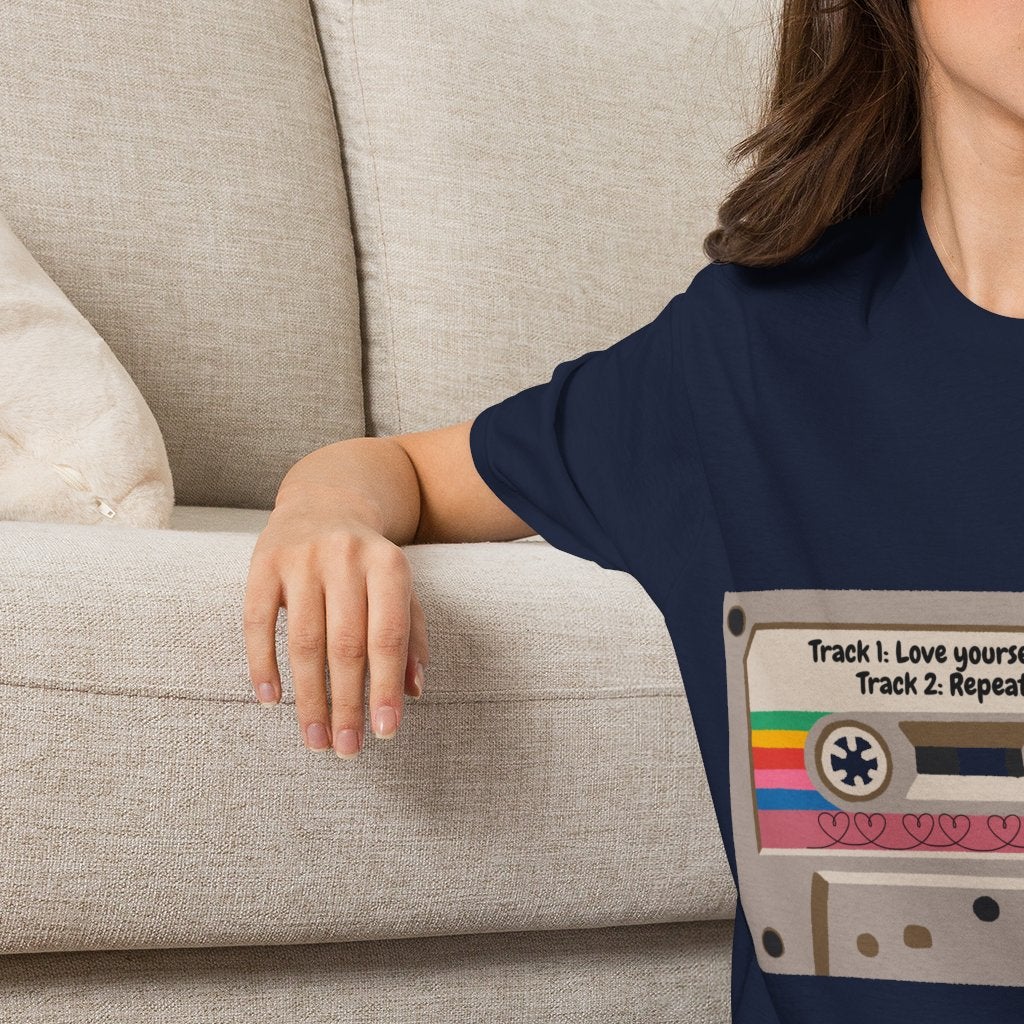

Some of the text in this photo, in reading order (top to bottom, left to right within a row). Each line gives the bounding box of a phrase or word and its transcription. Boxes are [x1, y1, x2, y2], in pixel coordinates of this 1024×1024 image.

[808, 639, 870, 664] Track
[875, 640, 889, 664] 1:
[895, 641, 948, 664] Love
[856, 671, 918, 696] Track
[924, 672, 944, 696] 2:
